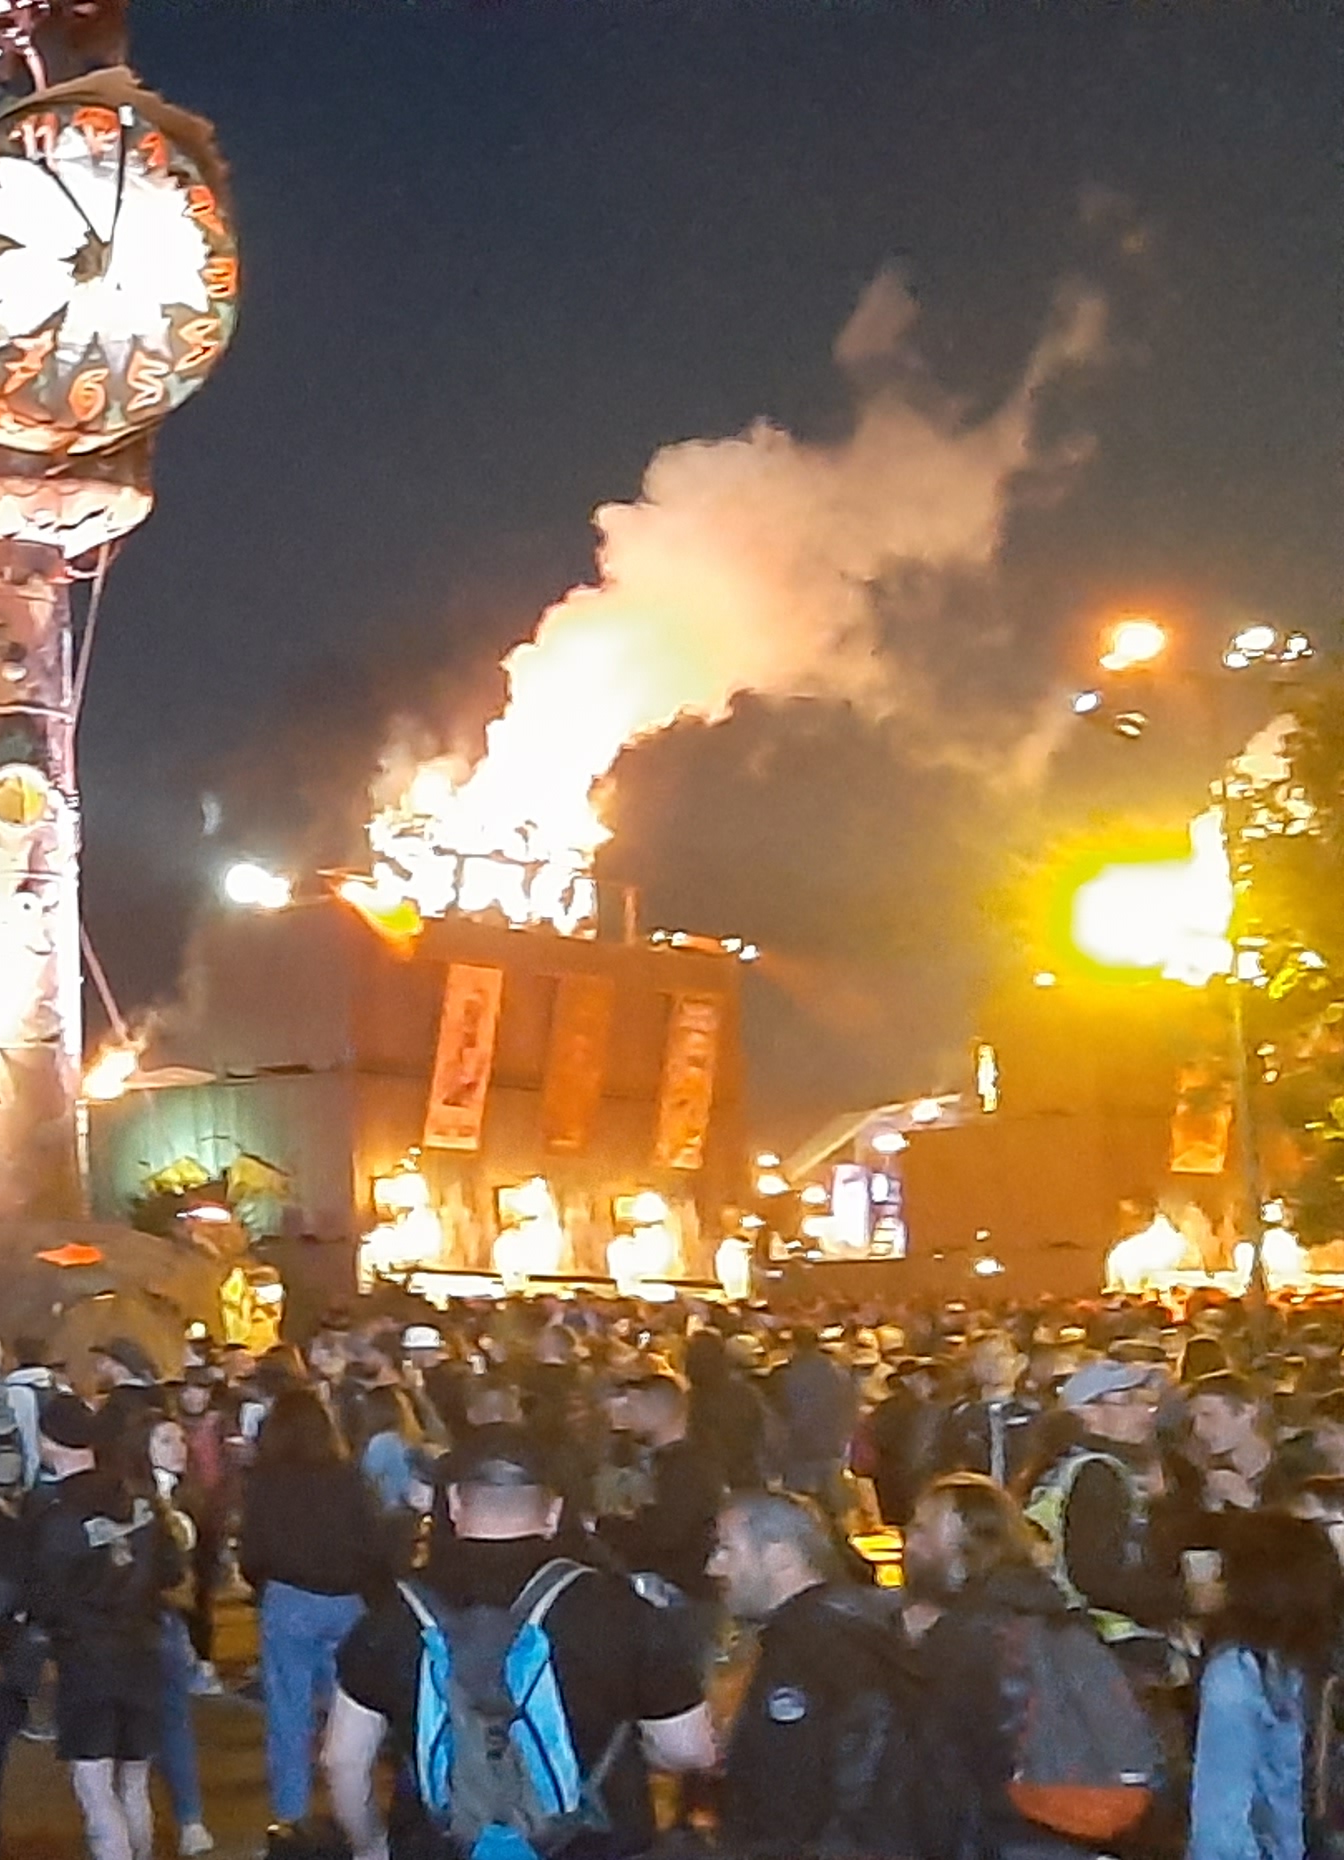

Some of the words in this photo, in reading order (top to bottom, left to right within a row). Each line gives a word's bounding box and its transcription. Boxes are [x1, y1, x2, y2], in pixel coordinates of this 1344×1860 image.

[8, 112, 57, 167] 11
[201, 256, 237, 299] 3
[4, 328, 55, 395] 7
[174, 317, 221, 372] 4
[69, 367, 110, 421] 6
[127, 351, 171, 412] 5
